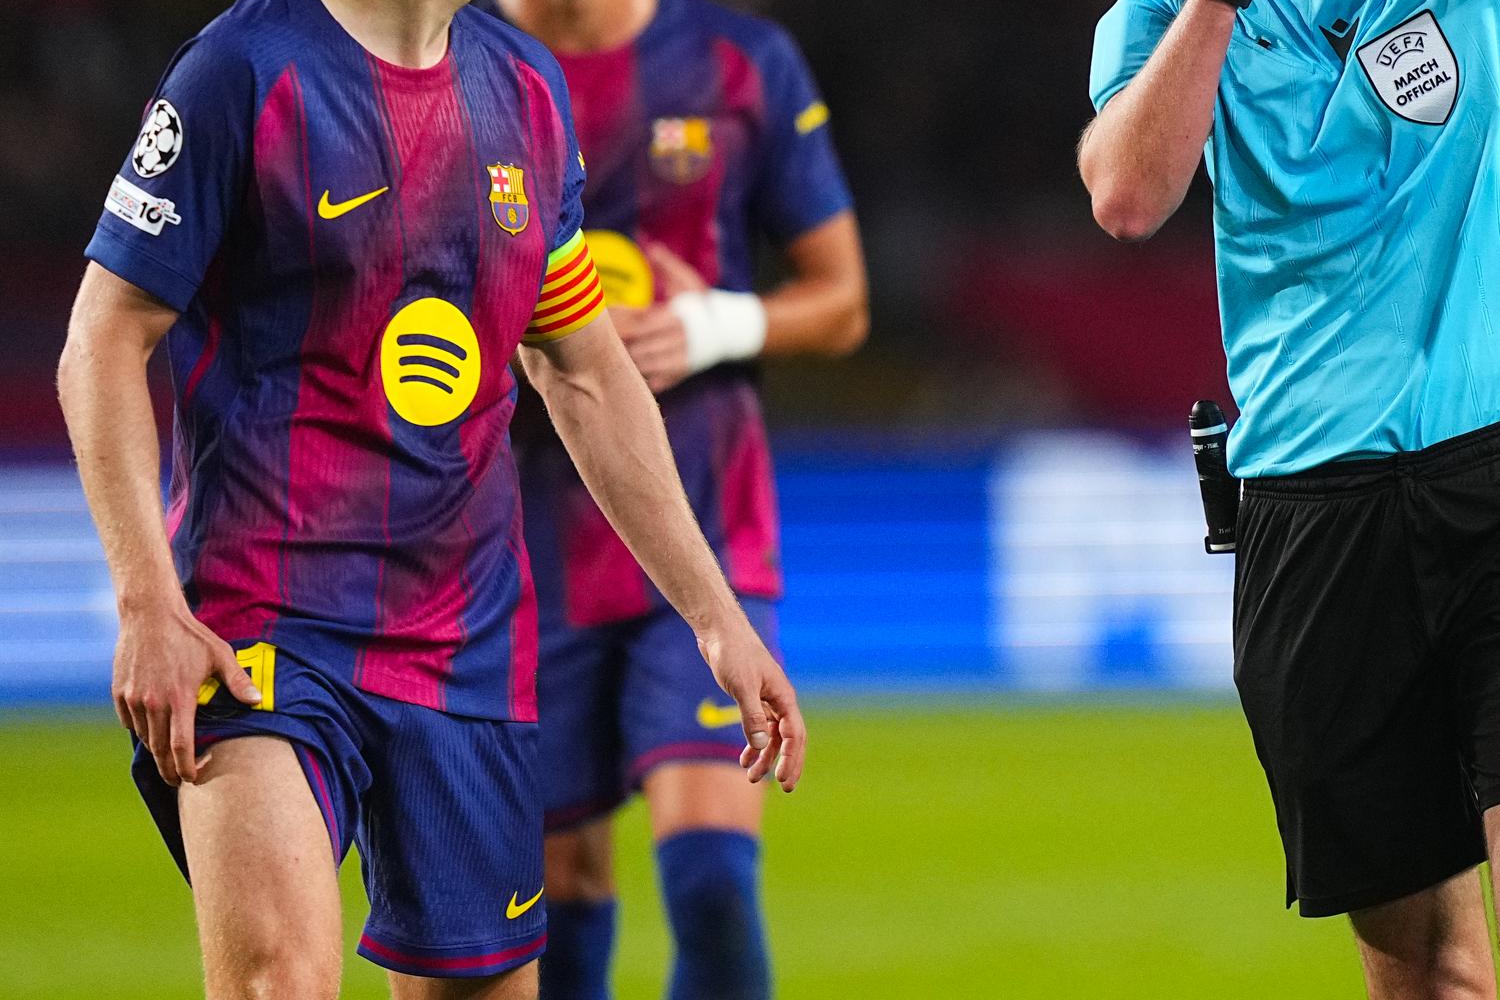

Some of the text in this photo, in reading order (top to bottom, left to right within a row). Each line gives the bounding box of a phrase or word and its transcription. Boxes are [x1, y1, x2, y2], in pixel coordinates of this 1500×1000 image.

[1380, 36, 1425, 67] UEFA
[1394, 58, 1439, 91] MATCH
[1396, 71, 1451, 107] OFFICIAL
